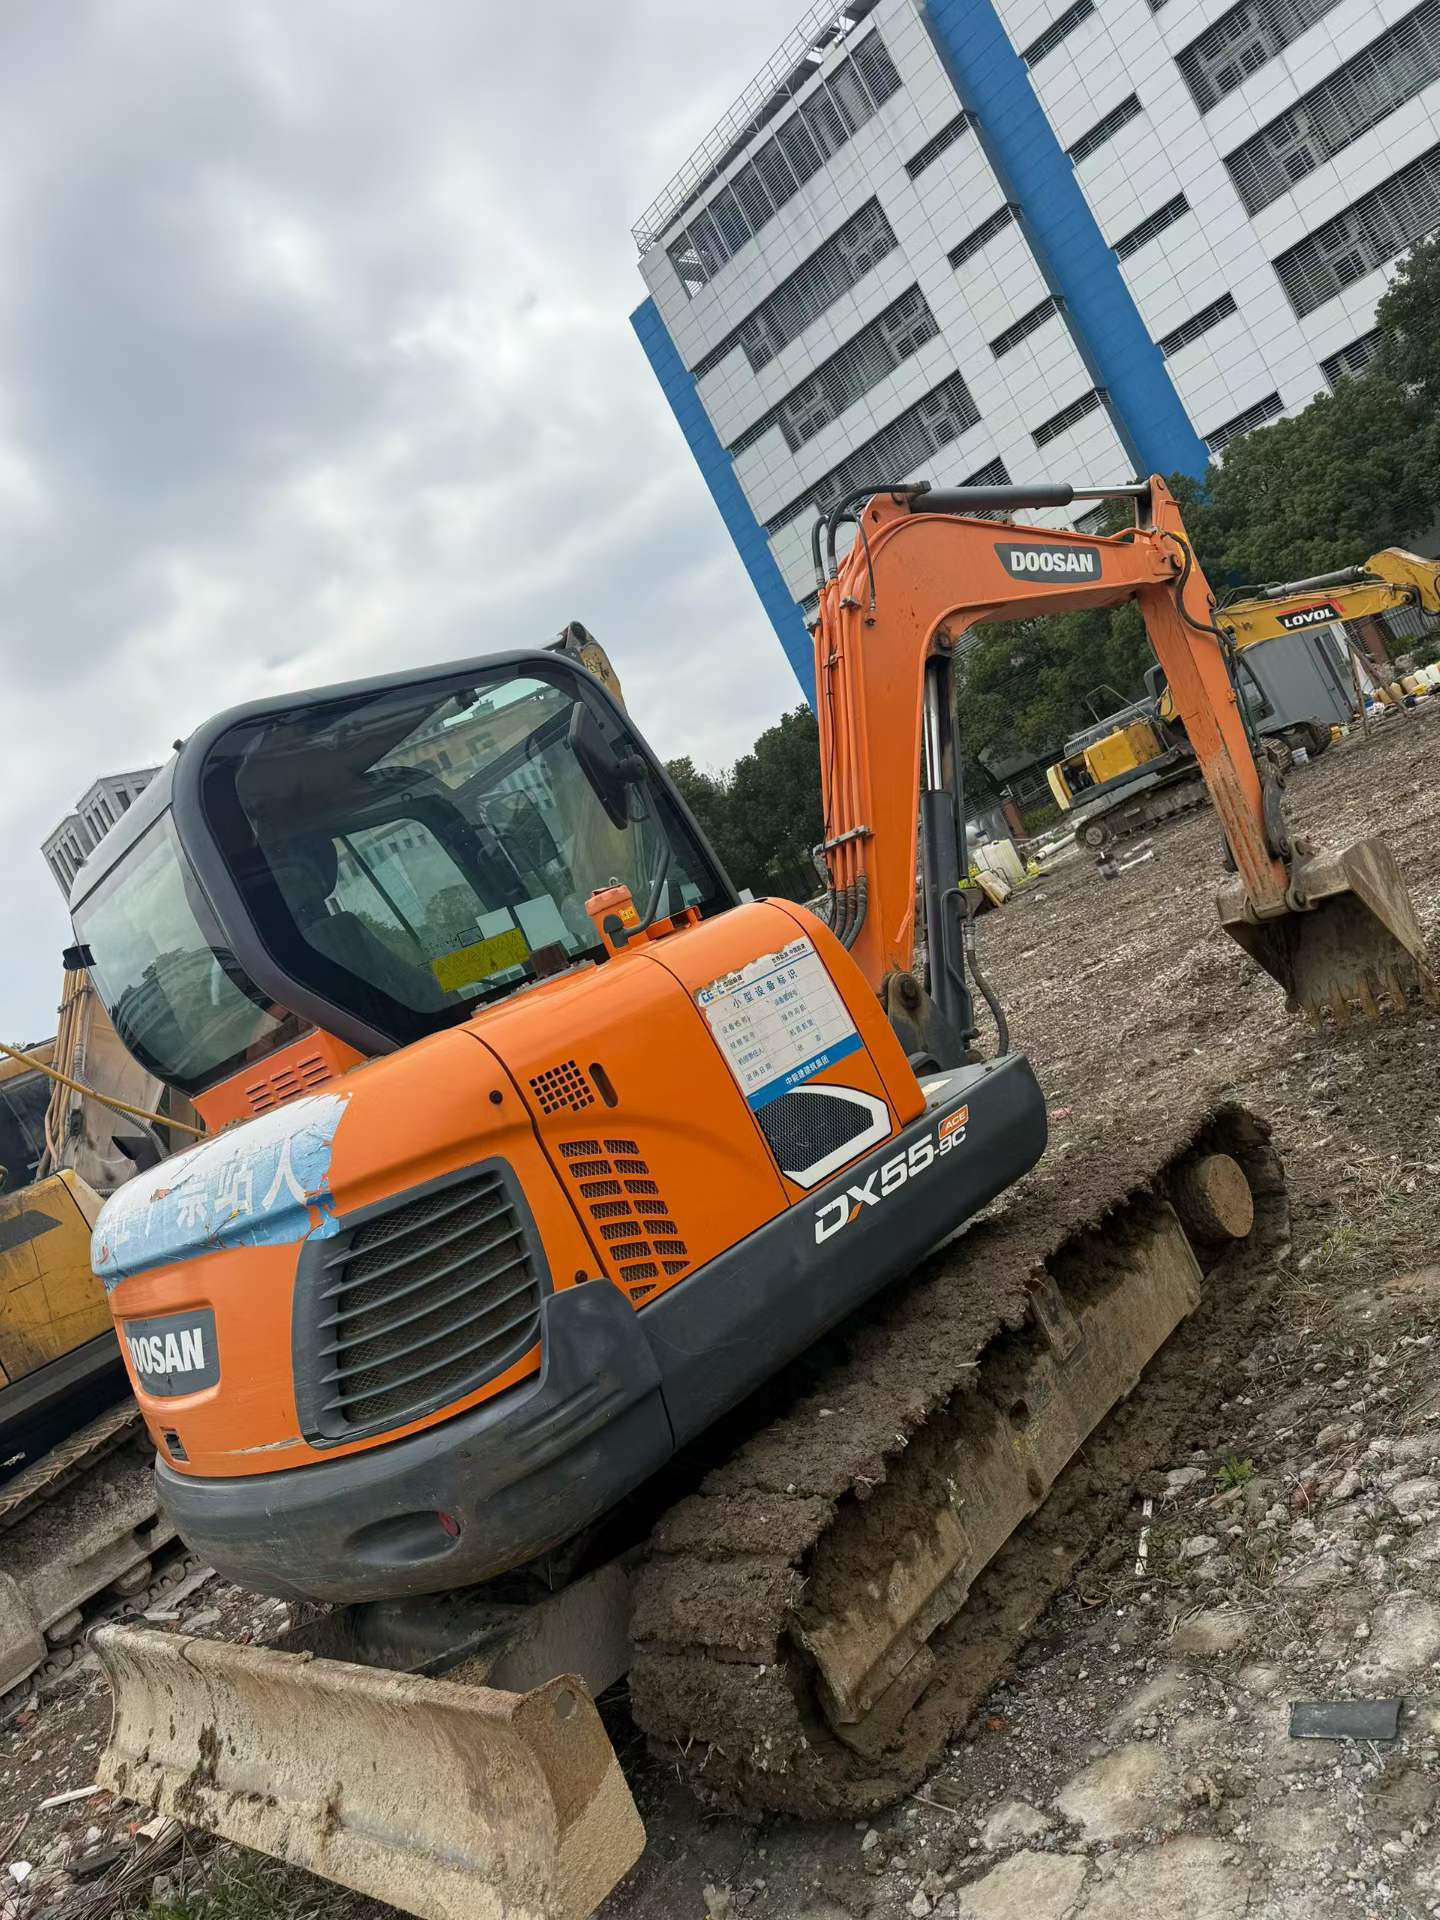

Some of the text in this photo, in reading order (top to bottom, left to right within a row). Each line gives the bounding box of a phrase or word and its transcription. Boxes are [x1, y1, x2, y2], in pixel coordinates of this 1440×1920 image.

[1010, 551, 1094, 573] DOOSAN
[1284, 608, 1334, 628] LOVOL
[733, 968, 798, 1009] 小型设备标识
[945, 1112, 965, 1131] ACE
